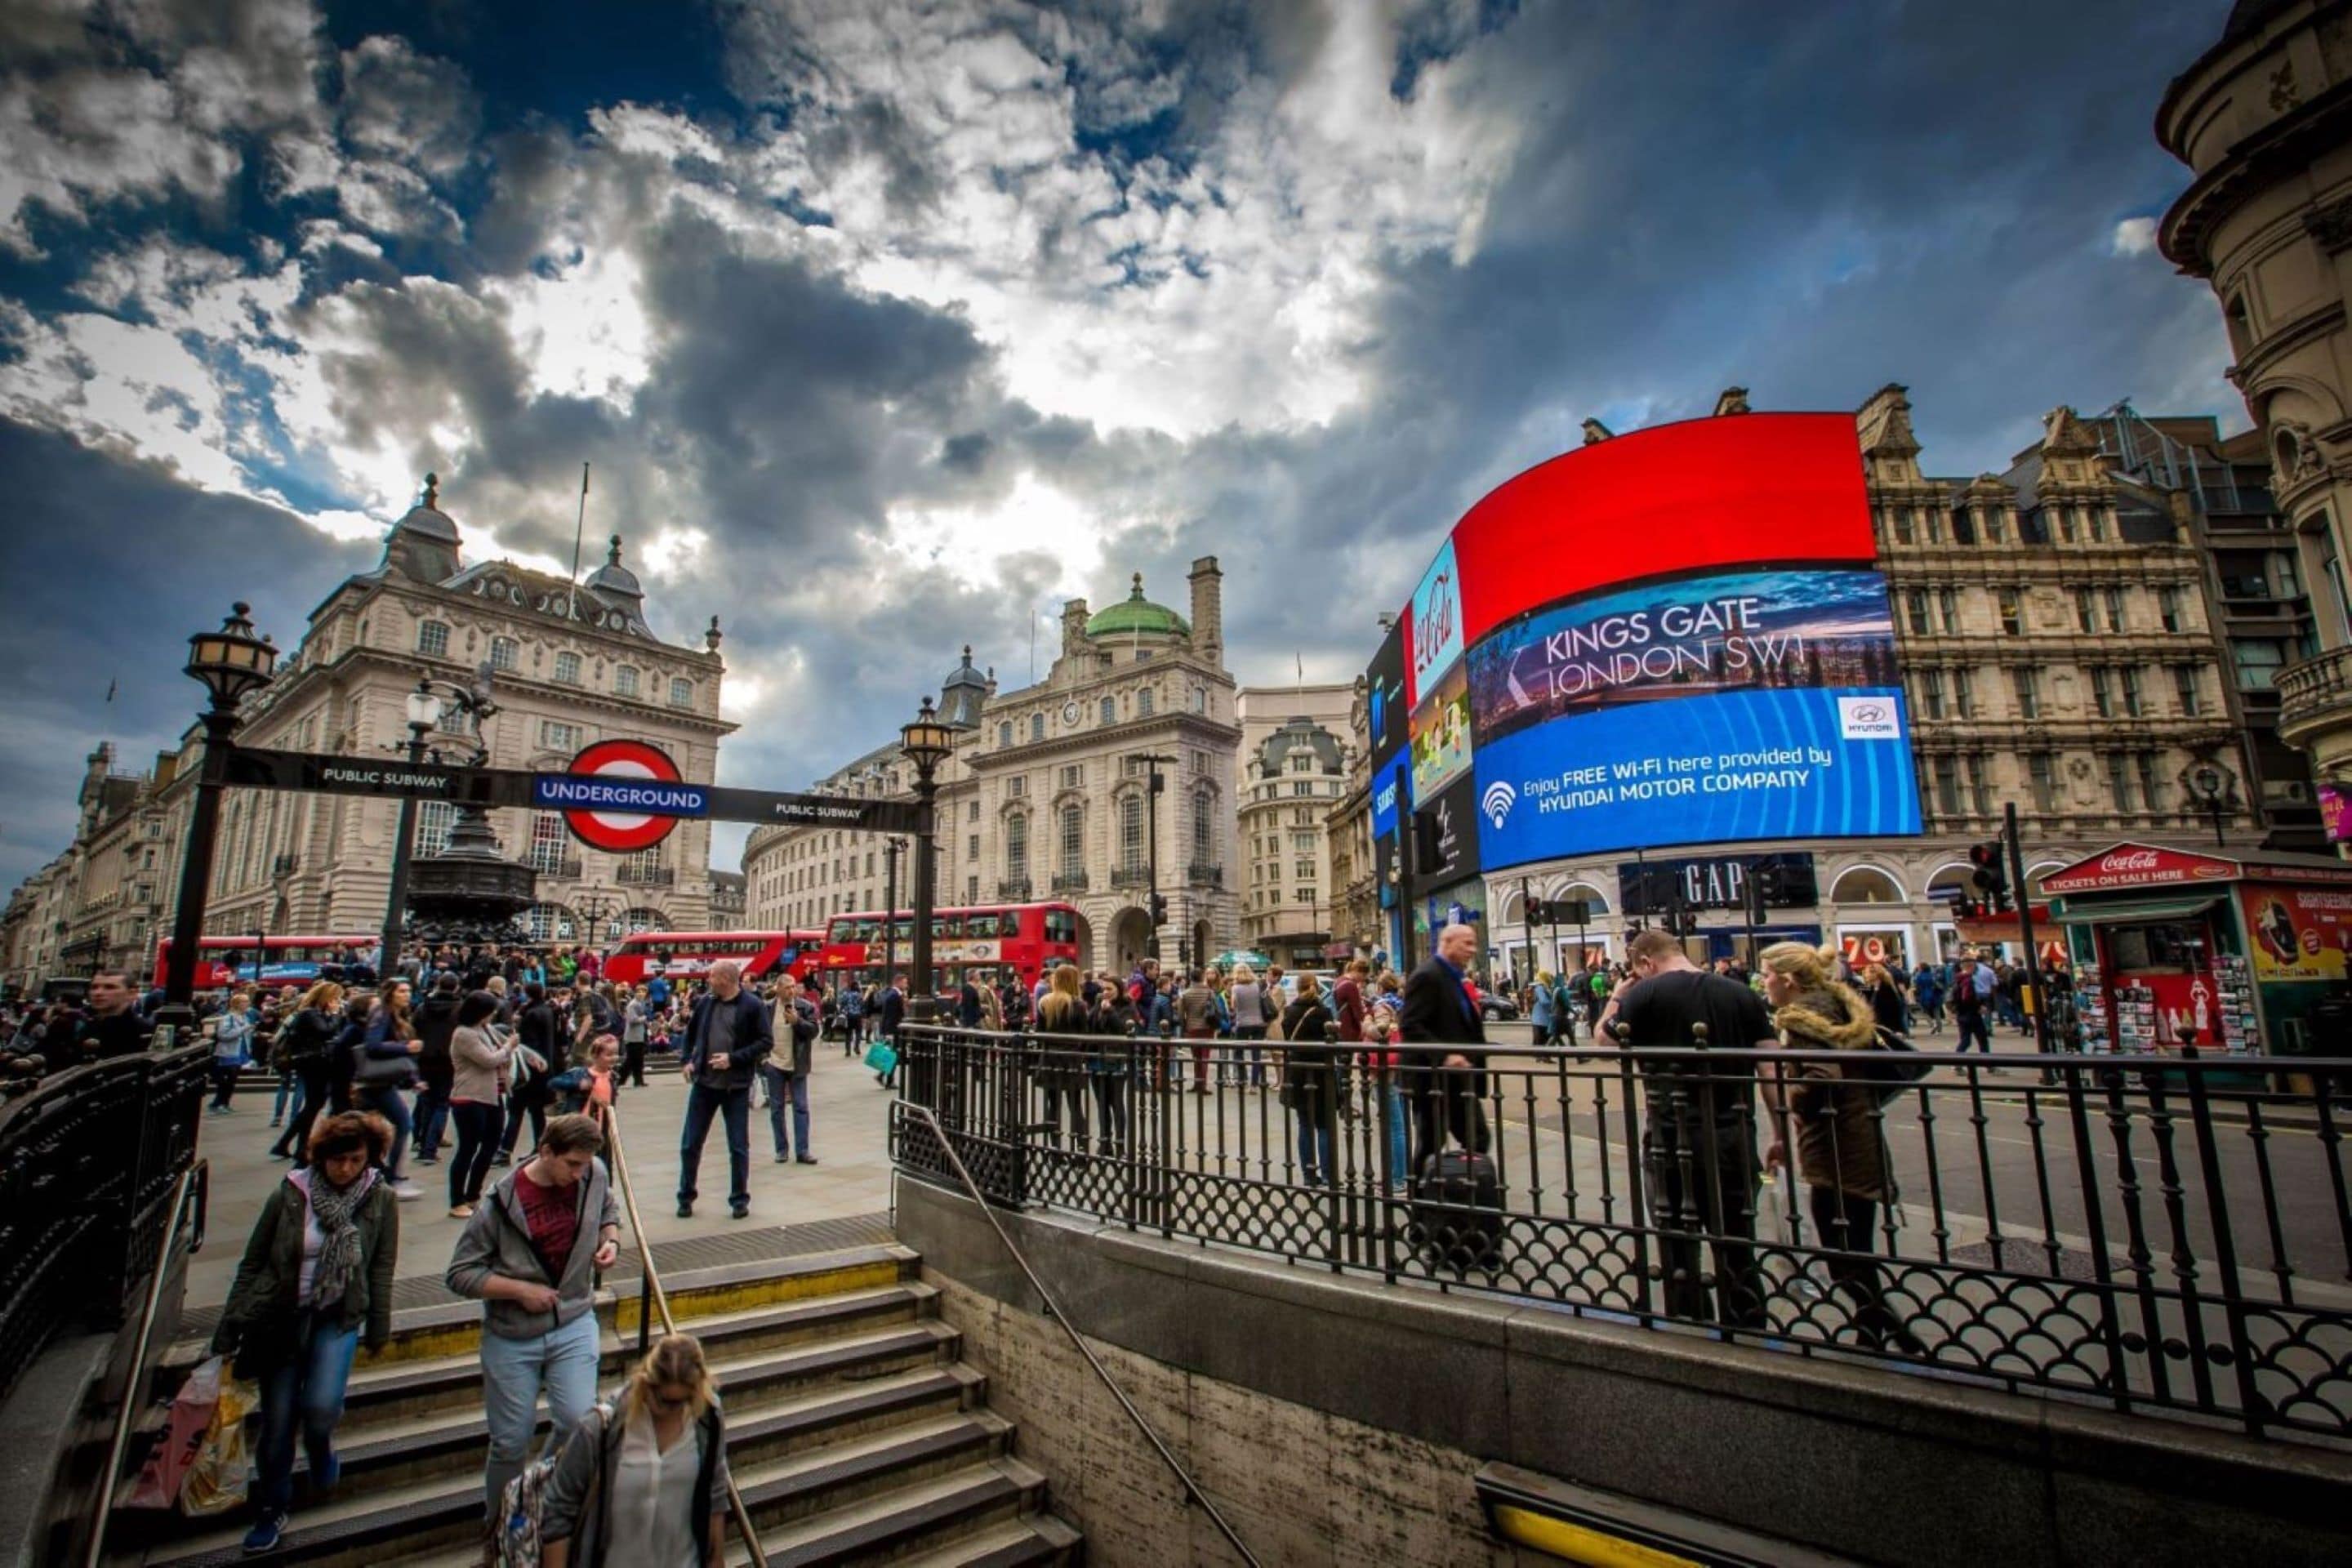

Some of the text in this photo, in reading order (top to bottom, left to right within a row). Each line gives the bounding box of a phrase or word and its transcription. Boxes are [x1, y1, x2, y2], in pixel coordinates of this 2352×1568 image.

[1546, 598, 1761, 664] KINGS GATE
[1548, 633, 1805, 698] LONDON SW1
[1848, 724, 1893, 733] HYUNDAI
[323, 768, 447, 789] PUBLIC SUBWAY
[1524, 746, 1832, 797] Enjoy FREE Wi-Fi here provided by
[541, 781, 702, 809] UNDERGROUND
[1539, 770, 1809, 813] HYUNDAI MOTOR COMPANY
[776, 803, 862, 820] PUBLIC SUBWAY
[1685, 862, 1744, 904] GAP
[2051, 877, 2096, 889] TICKETS
[2099, 875, 2118, 885] ON
[2120, 872, 2149, 884] SALE
[2152, 869, 2184, 880] HERE
